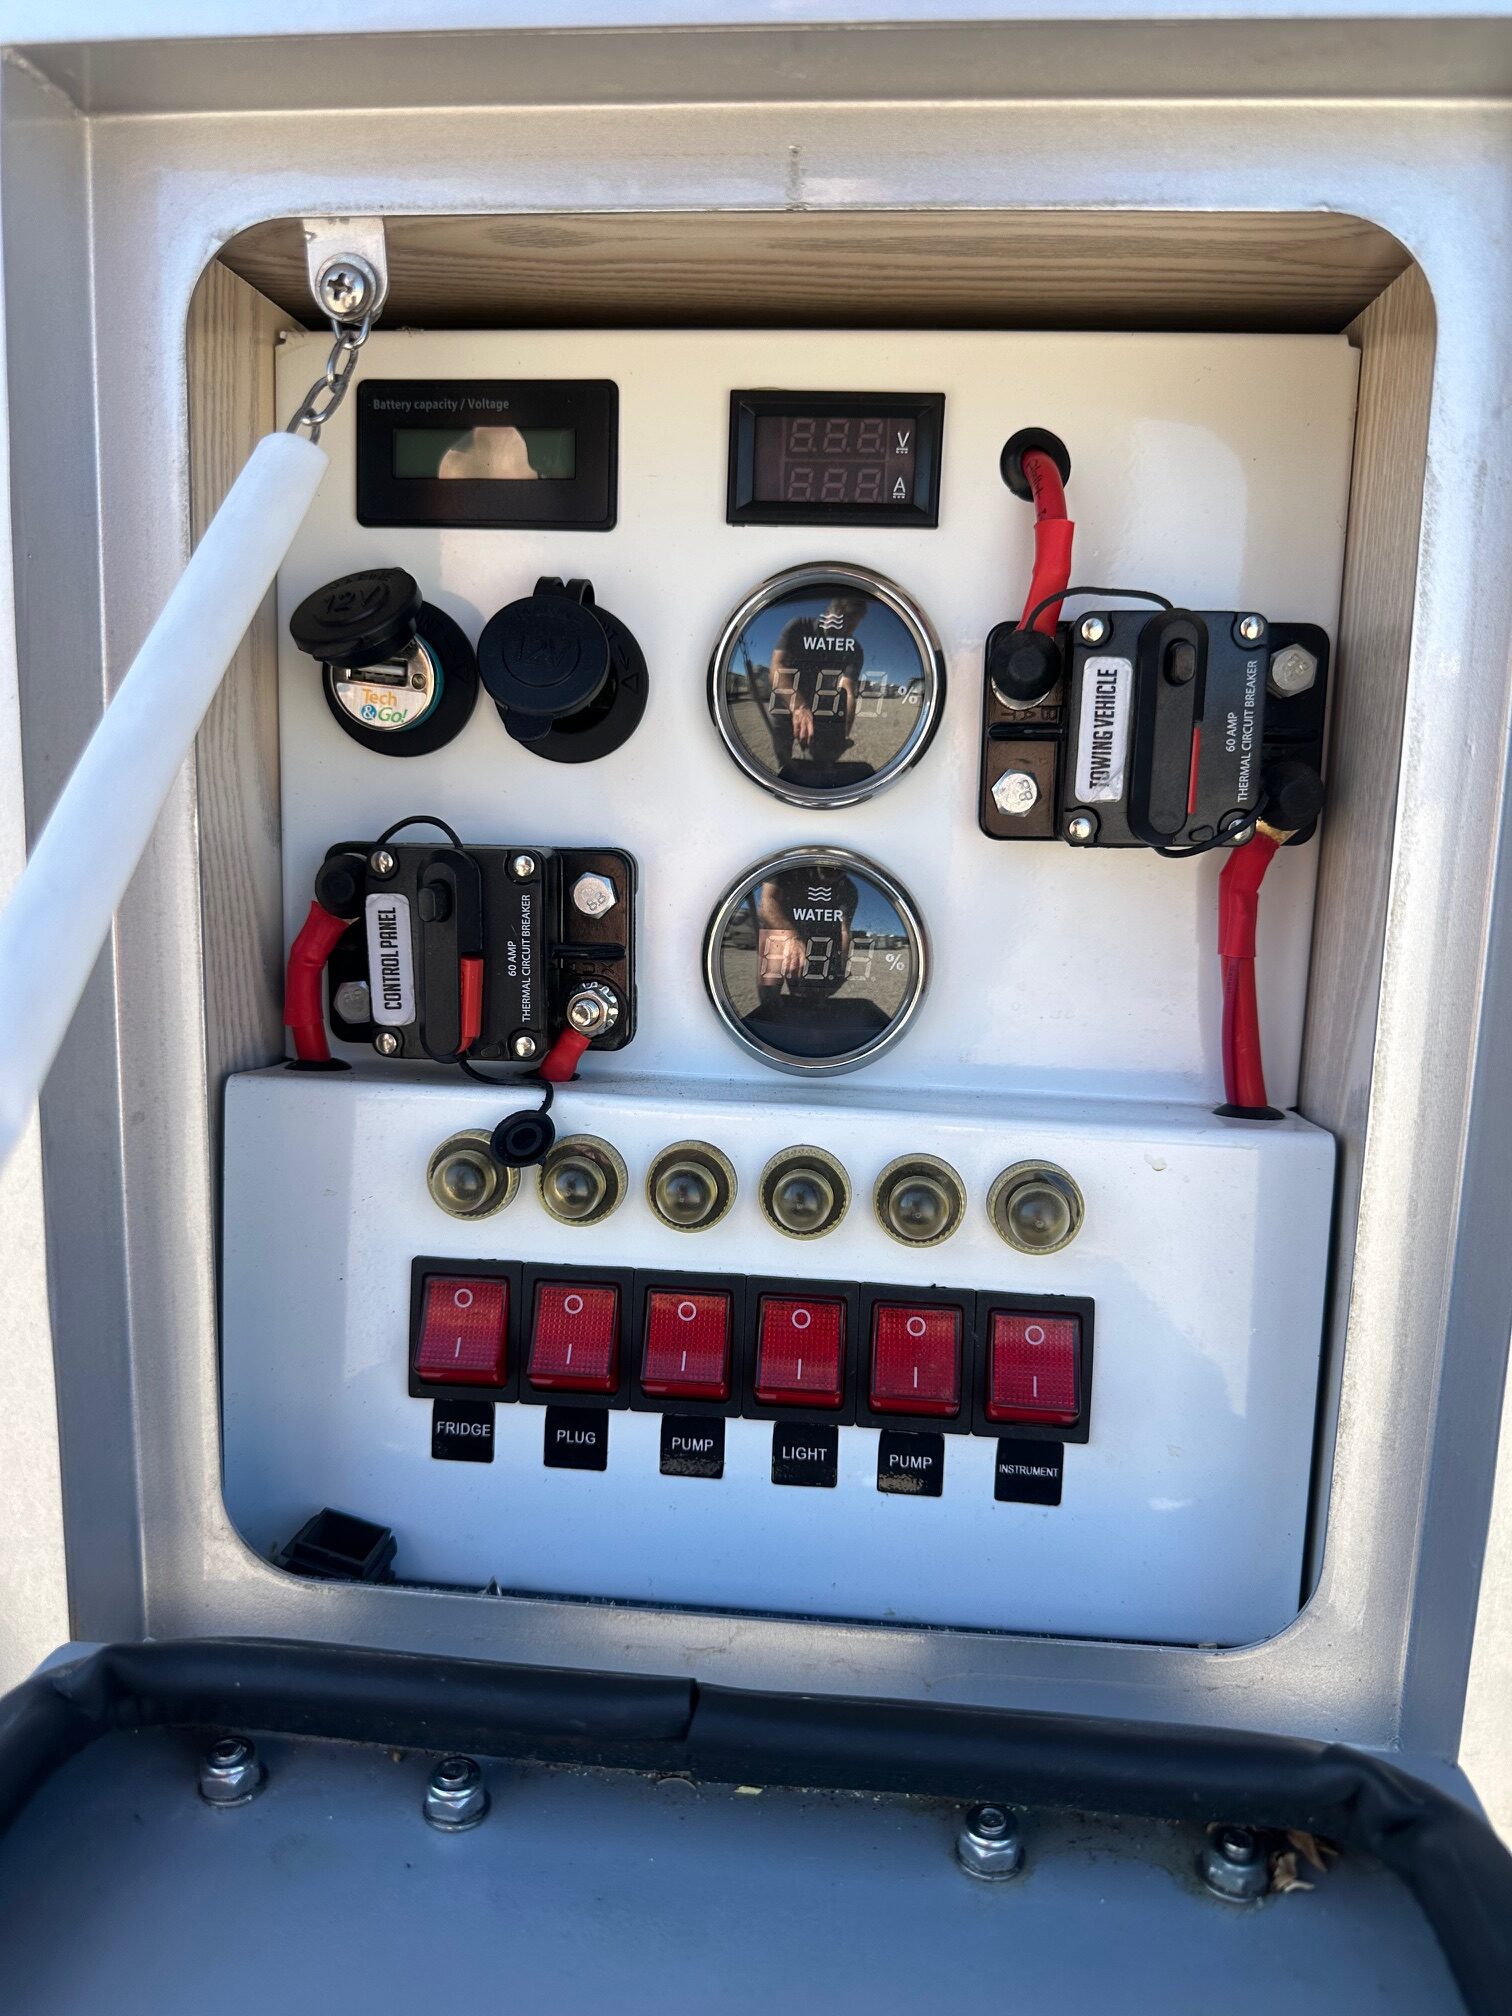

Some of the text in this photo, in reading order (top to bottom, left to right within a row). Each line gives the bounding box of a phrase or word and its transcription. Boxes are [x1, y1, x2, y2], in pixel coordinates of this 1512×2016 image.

[373, 398, 510, 413] Battery capacity / Voltage
[897, 431, 910, 448] V
[893, 477, 906, 493] A
[803, 636, 855, 652] WATER
[362, 688, 398, 706] Tech
[1089, 669, 1118, 789] TOWING VEHICLE
[1225, 711, 1238, 753] 60 AMP
[1237, 660, 1258, 803] THERMAL CIRCUIT BREAKER
[793, 908, 844, 922] WATER
[378, 907, 402, 1010] CONTROL PANEL
[507, 940, 517, 977] 60 AMP
[521, 894, 531, 1023] THERMAL CIRCUIT BREAKER
[437, 1420, 491, 1438] FRIDGE
[556, 1429, 596, 1445] PLUG
[671, 1436, 714, 1452] PUMP
[782, 1445, 827, 1463] LIGHT
[889, 1454, 933, 1470] PUMP
[999, 1463, 1059, 1479] INSTRUMENT
